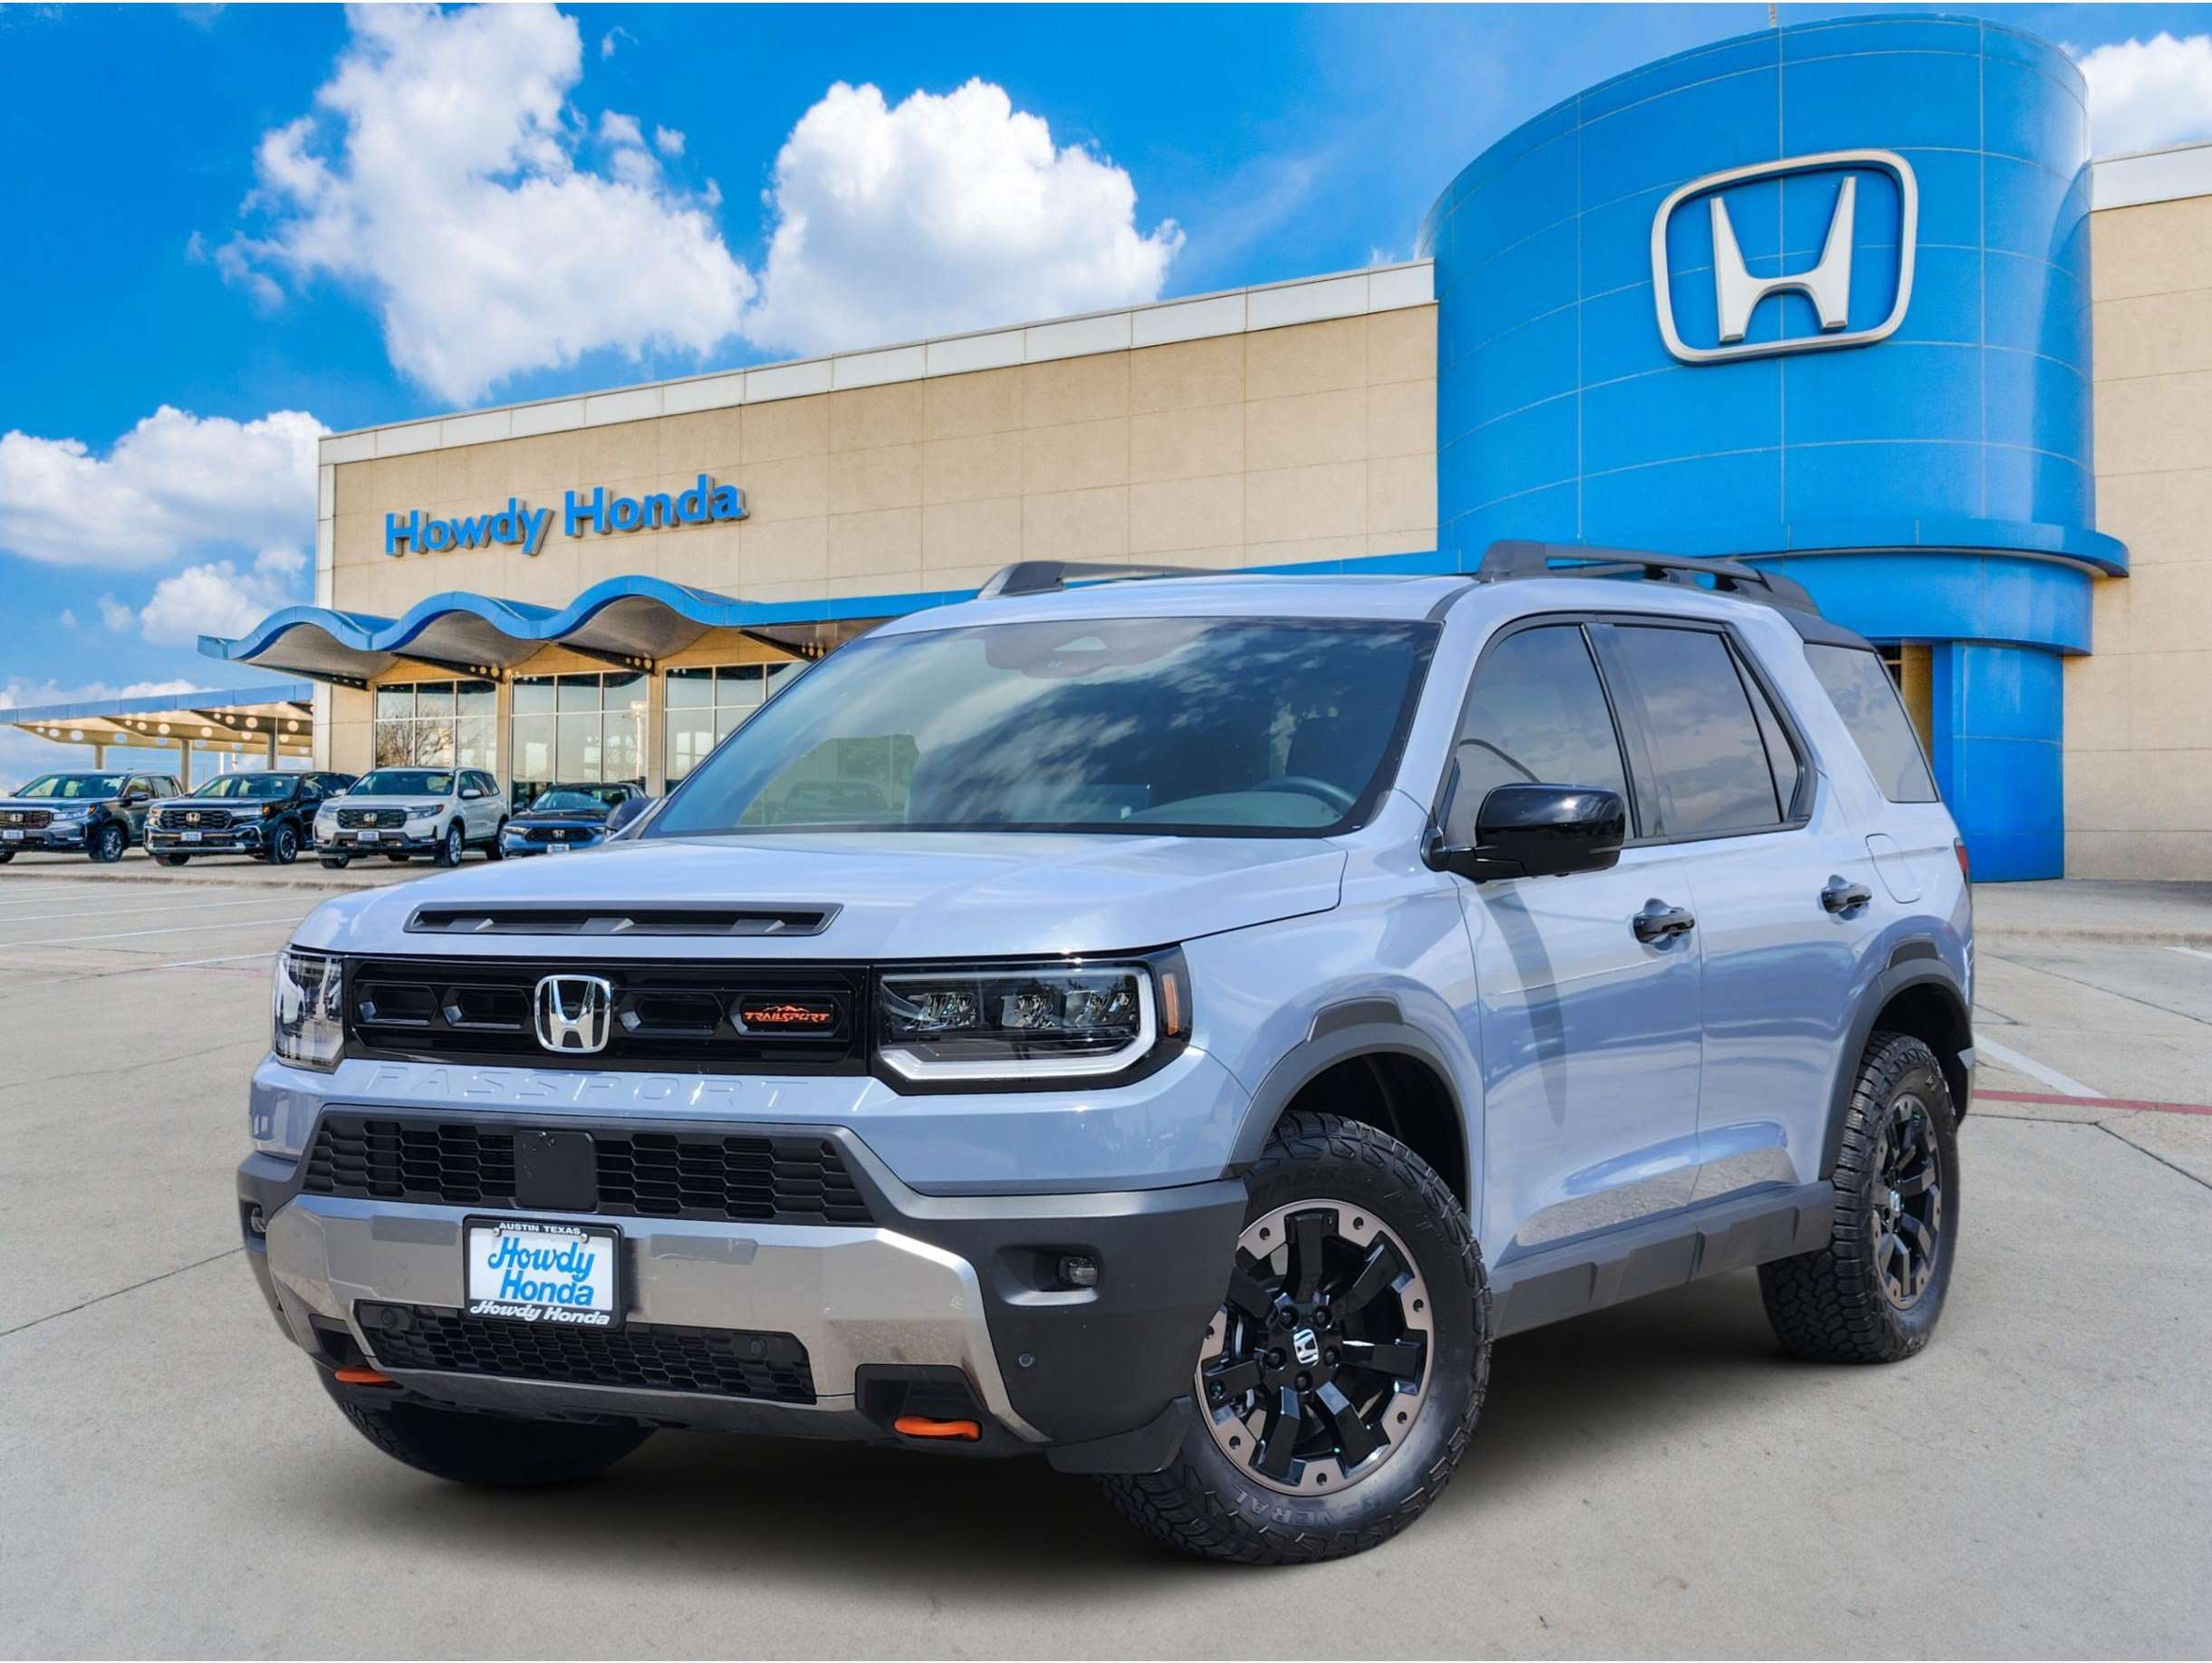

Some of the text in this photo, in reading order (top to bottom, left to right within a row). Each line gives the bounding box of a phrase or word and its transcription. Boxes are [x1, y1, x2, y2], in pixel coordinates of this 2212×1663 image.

[384, 473, 749, 557] Howdy Honda
[366, 1066, 809, 1109] PASSPORT
[499, 1222, 582, 1235] AUSTIN TEXAS
[487, 1236, 595, 1283] Howdy
[499, 1269, 595, 1306] Honda
[470, 1300, 611, 1325] Howdy Honda
